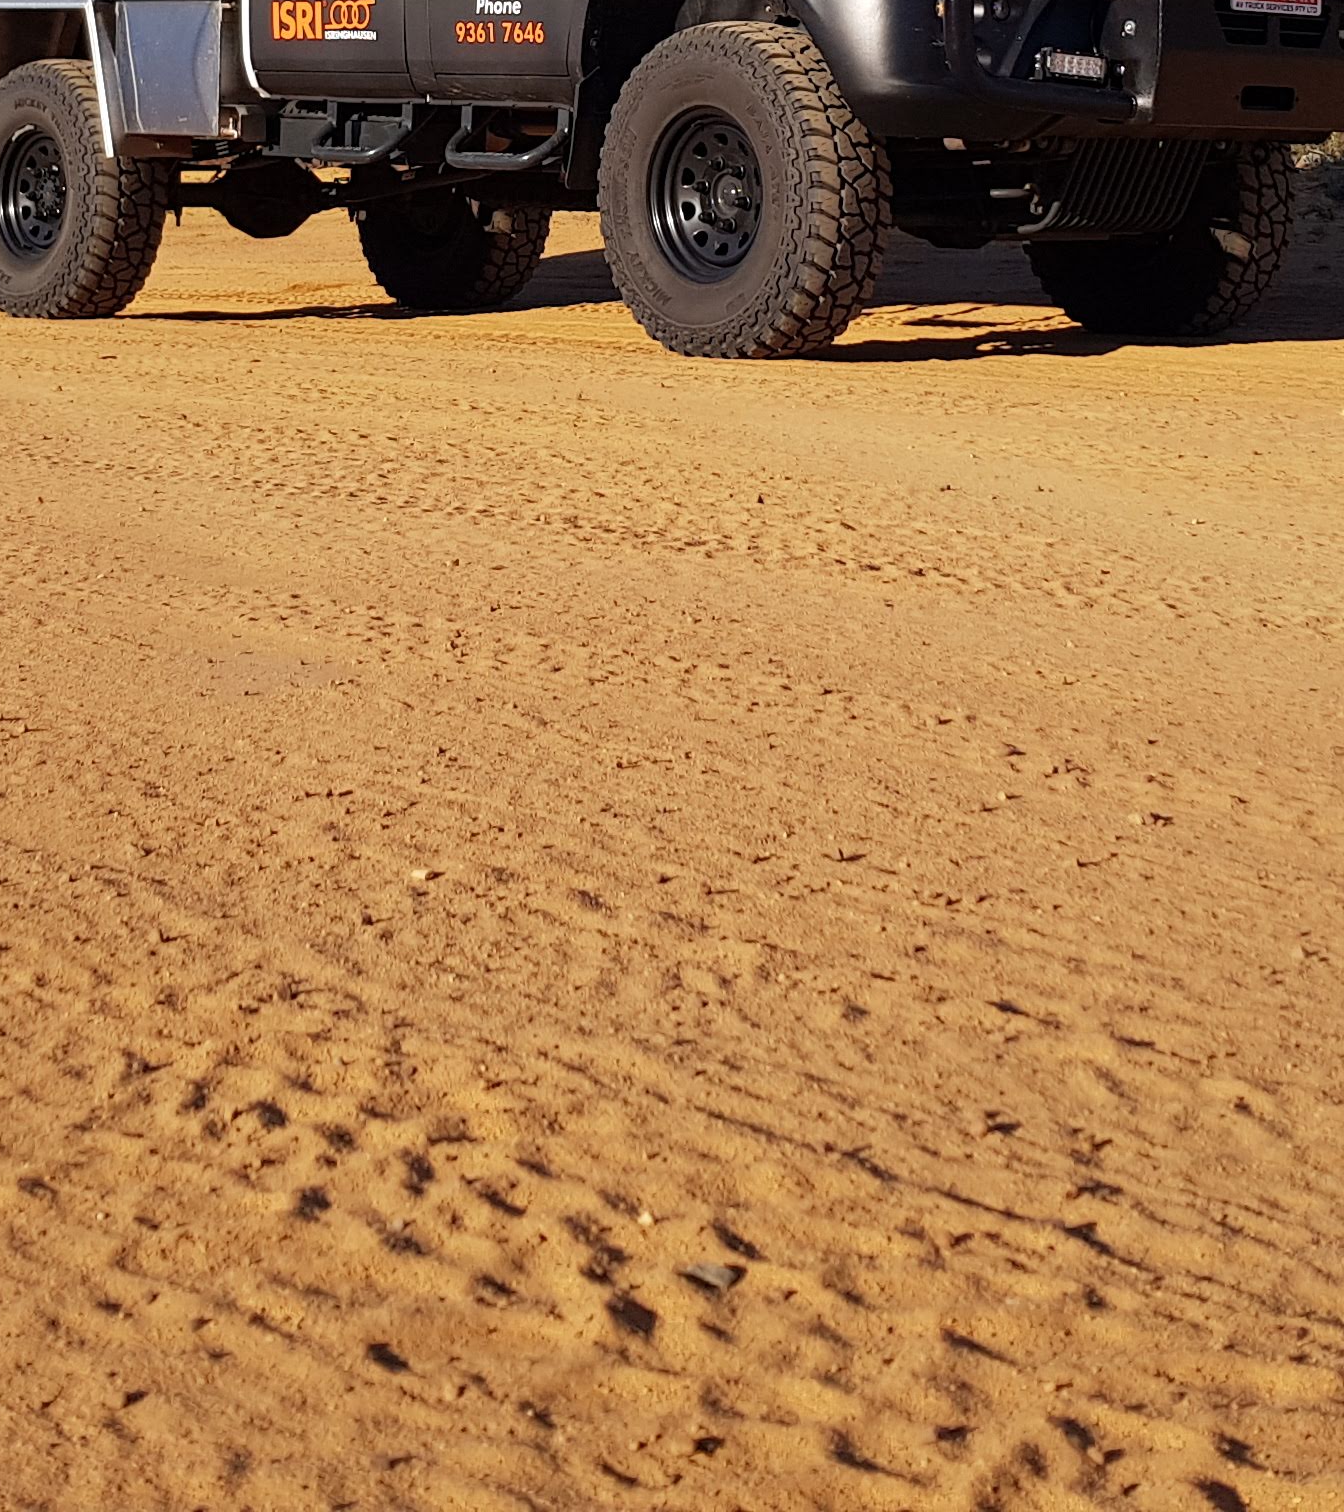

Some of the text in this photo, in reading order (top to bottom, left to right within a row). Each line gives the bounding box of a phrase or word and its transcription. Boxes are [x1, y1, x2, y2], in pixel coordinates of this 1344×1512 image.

[1245, 2, 1265, 10] TRUCK
[1265, 3, 1294, 12] SERVICES
[1306, 6, 1318, 14] LTD
[272, 0, 323, 40] ISRI
[324, 30, 377, 41] ISRINGHAUSEN
[455, 22, 545, 44] 9361 7646
